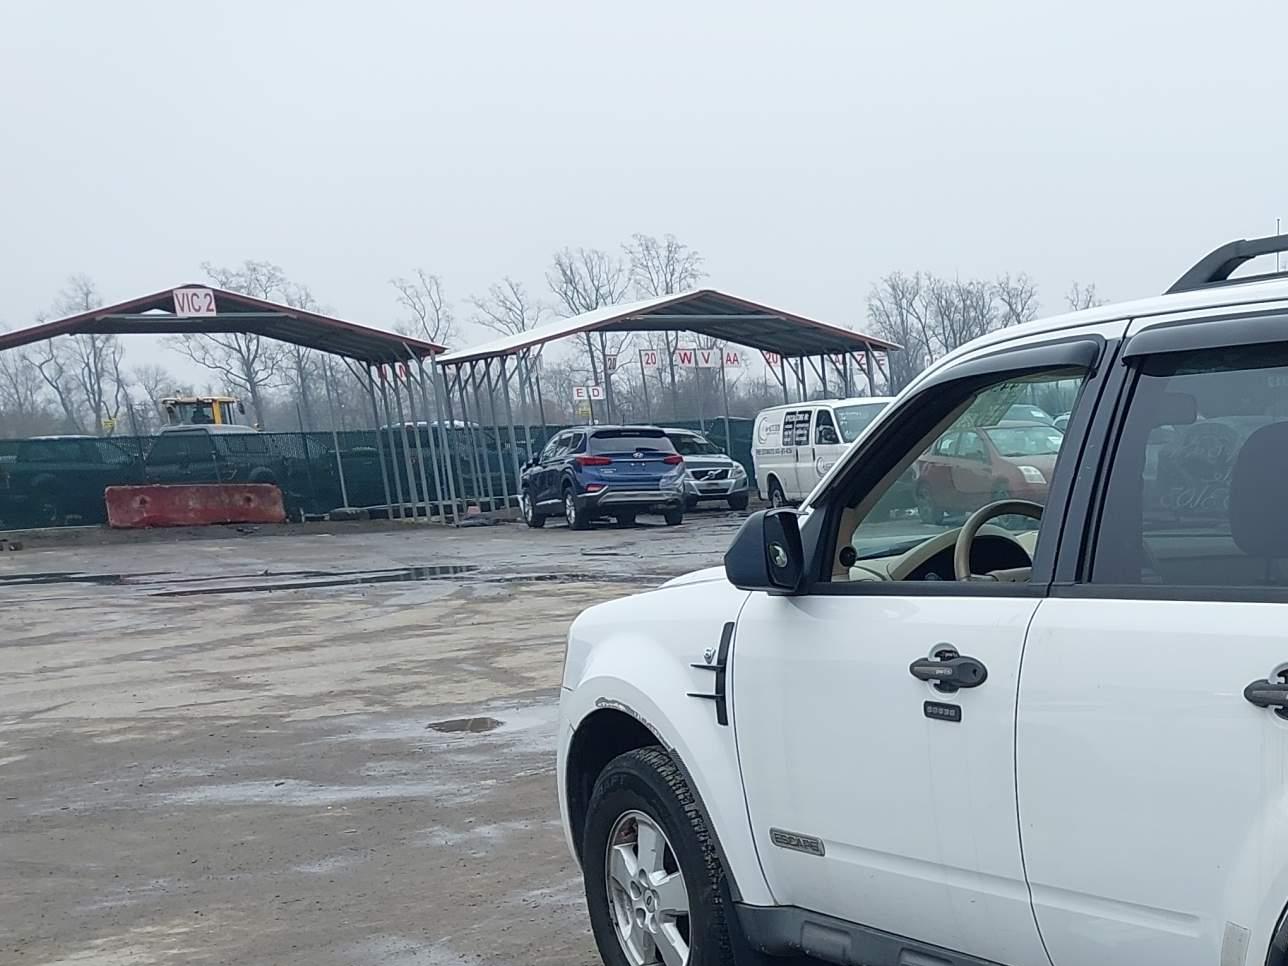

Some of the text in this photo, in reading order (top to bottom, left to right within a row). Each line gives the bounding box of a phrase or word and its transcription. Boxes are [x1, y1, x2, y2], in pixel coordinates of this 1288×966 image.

[175, 292, 215, 313] VIC 2
[607, 356, 617, 370] 20
[644, 352, 657, 365] 20
[678, 351, 693, 364] W
[701, 351, 711, 364] V
[725, 351, 740, 365] AA
[575, 388, 584, 398] E
[591, 388, 600, 398] D
[773, 832, 821, 853] ESCAPE
